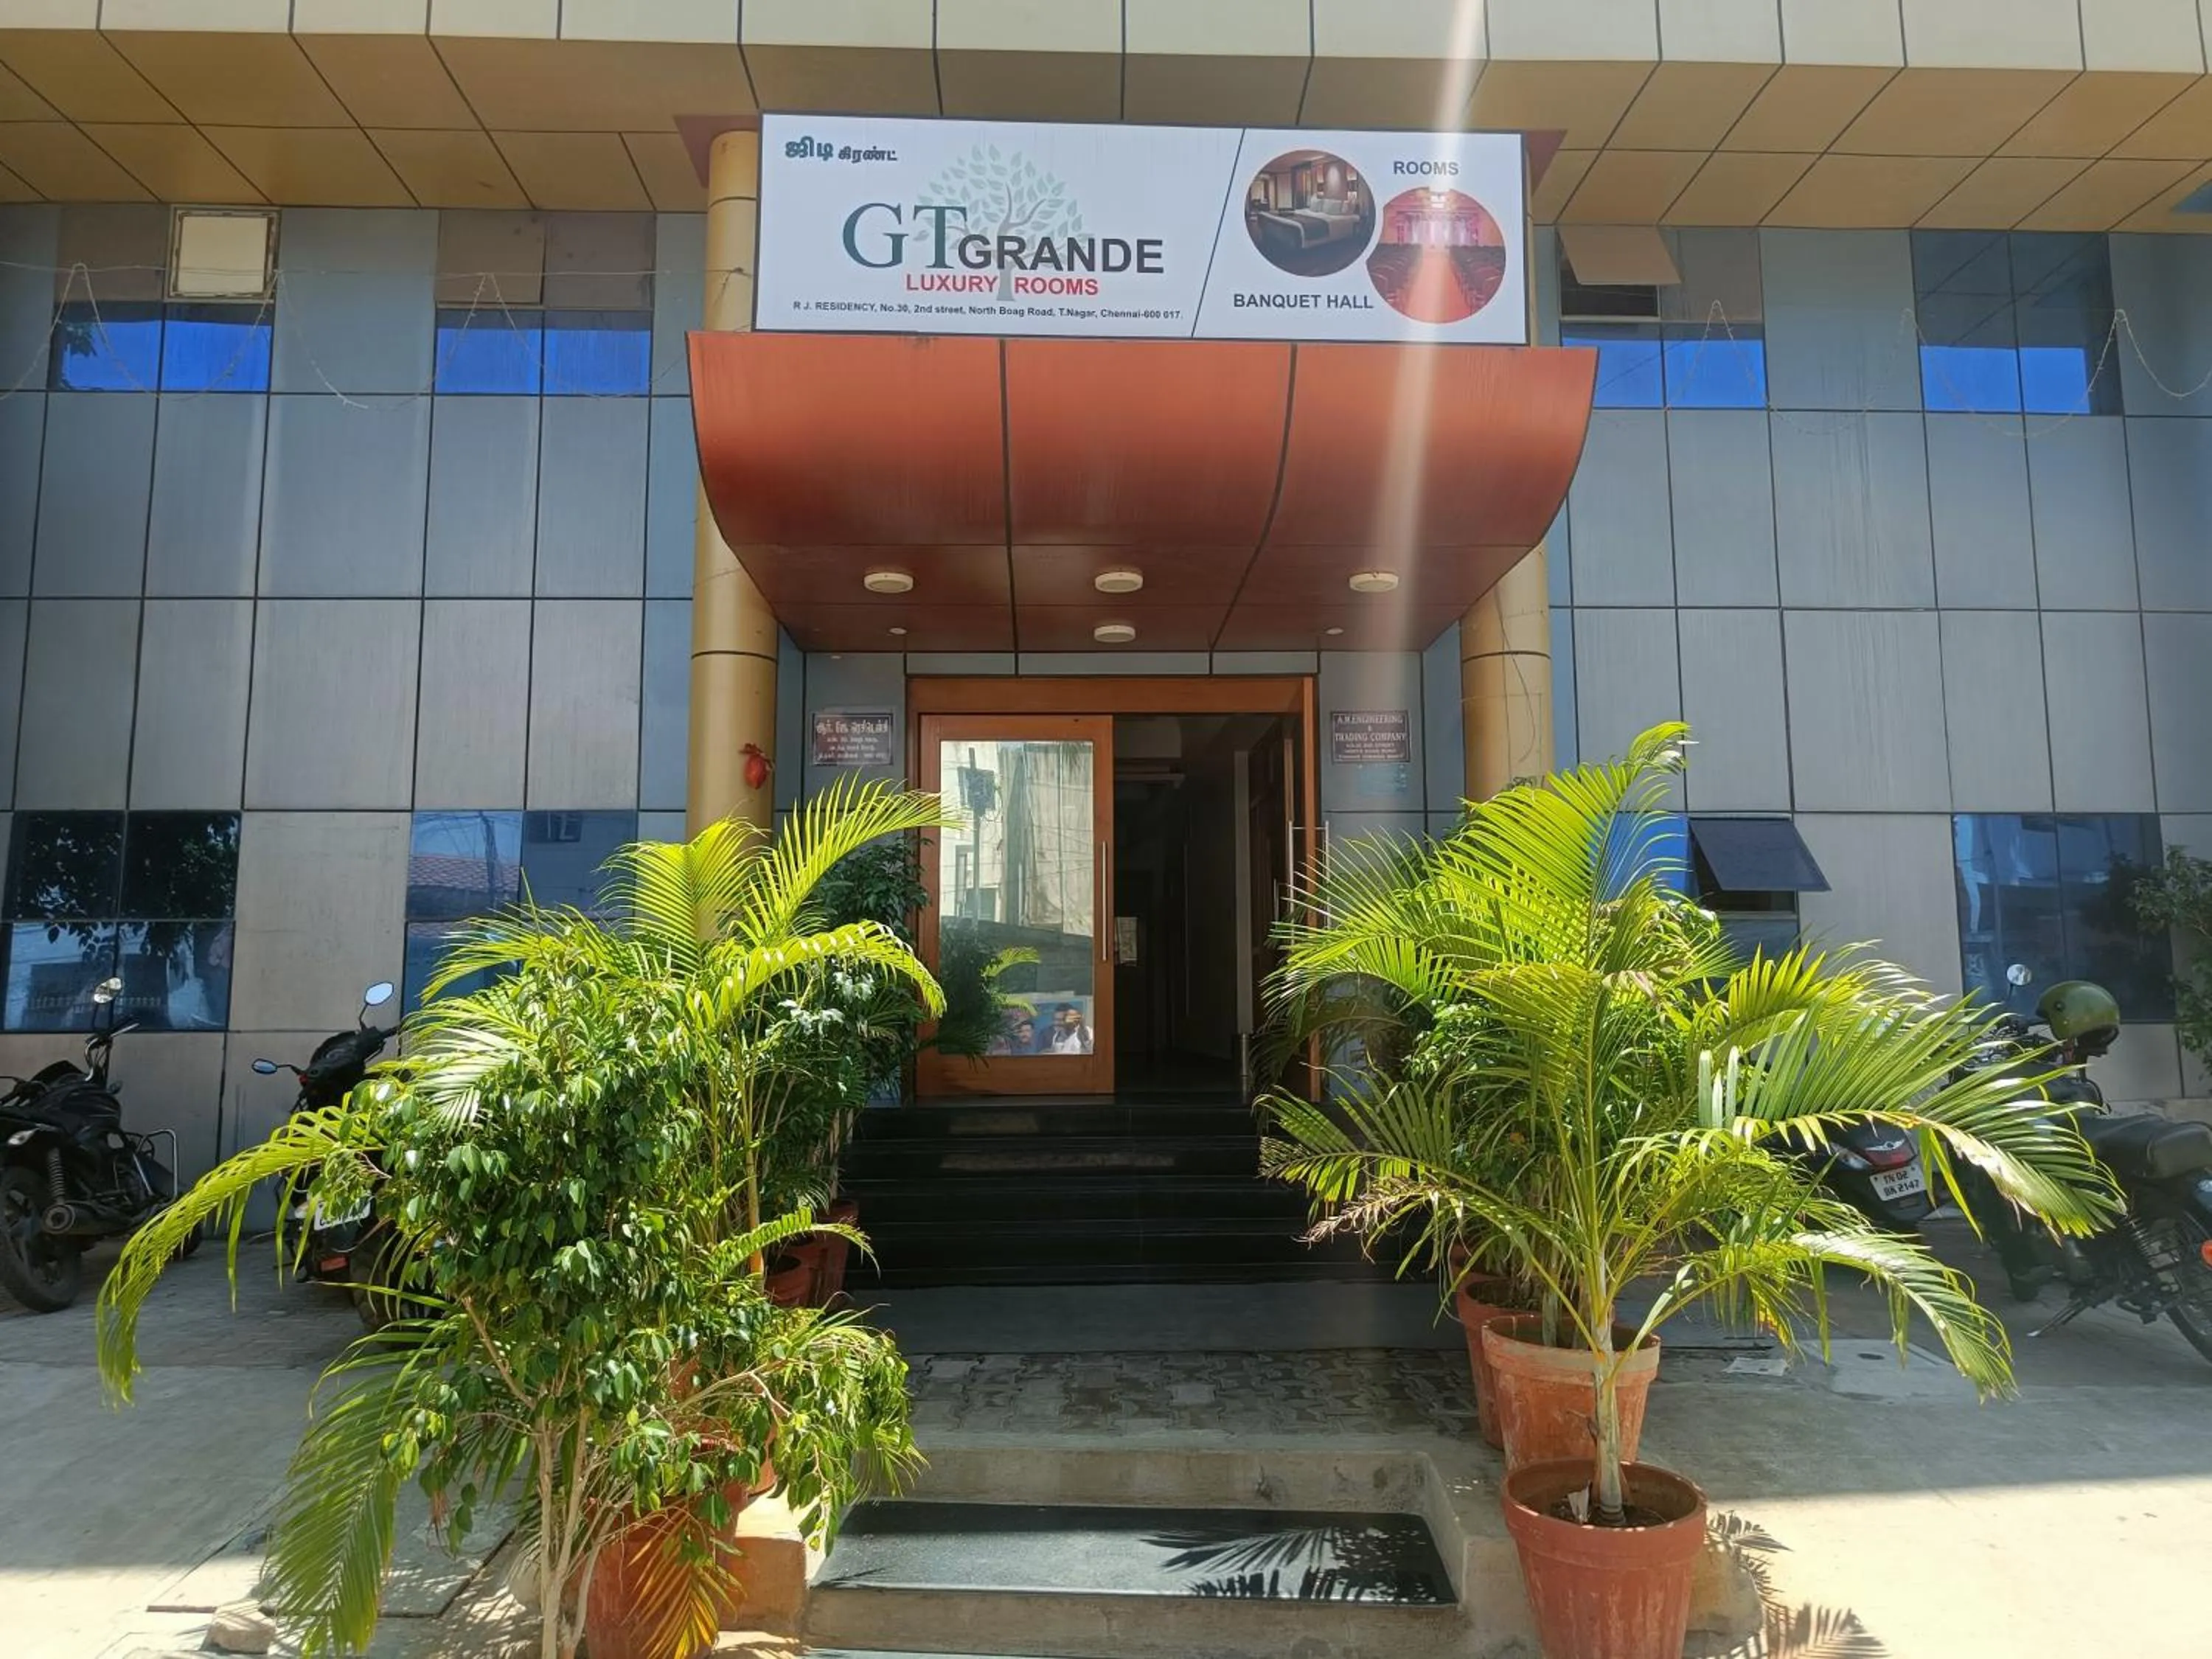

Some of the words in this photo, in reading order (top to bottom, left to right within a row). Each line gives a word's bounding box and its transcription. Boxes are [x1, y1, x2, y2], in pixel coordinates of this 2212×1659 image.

[1393, 161, 1459, 175] ROOMS
[843, 203, 967, 269] GT
[958, 234, 1164, 274] GRANDE
[906, 274, 998, 293] LUXURY
[1015, 276, 1099, 295] ROOMS
[1234, 293, 1321, 308] BANQUET
[1327, 295, 1374, 309] HALL
[815, 302, 877, 313] RESIDENCY,
[914, 304, 932, 313] 2nd
[969, 306, 996, 315] North
[999, 306, 1025, 318] Boag
[1058, 307, 1098, 319] T.Nagar,
